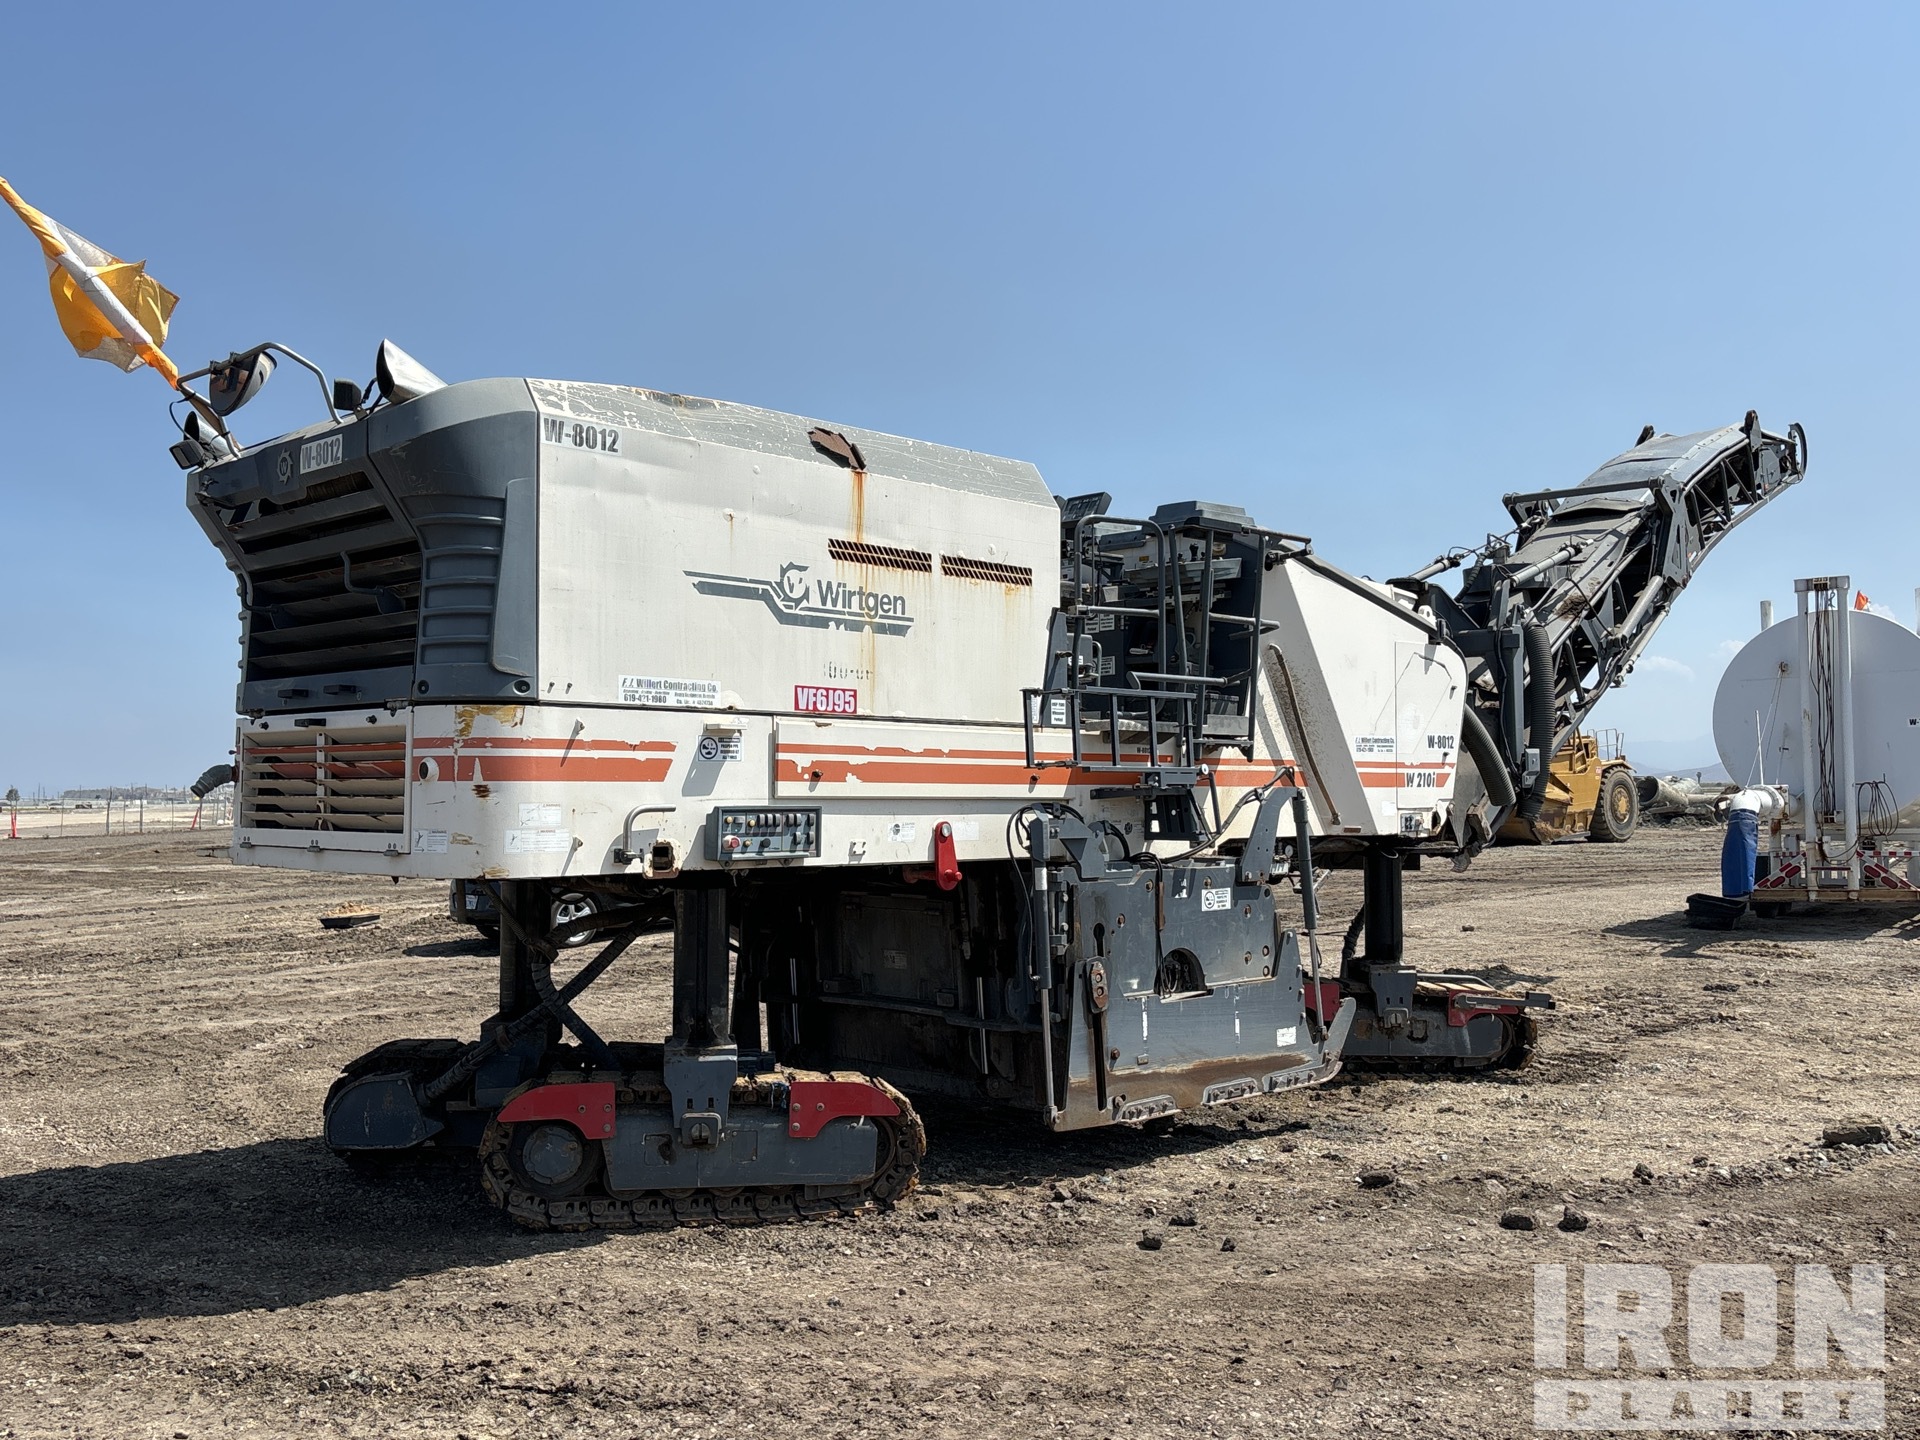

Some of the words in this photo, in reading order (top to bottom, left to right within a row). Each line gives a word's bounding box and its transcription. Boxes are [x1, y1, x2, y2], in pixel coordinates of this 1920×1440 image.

[543, 417, 620, 453] W-8012
[301, 437, 341, 471] W-8012
[816, 579, 906, 620] Wirtgen
[636, 678, 662, 689] Willert
[663, 680, 706, 693] Contracting
[707, 682, 719, 693] Co.
[796, 687, 855, 713] VF6J95
[1427, 735, 1454, 749] W-8012
[1406, 772, 1415, 788] W
[1416, 771, 1436, 788] 210i
